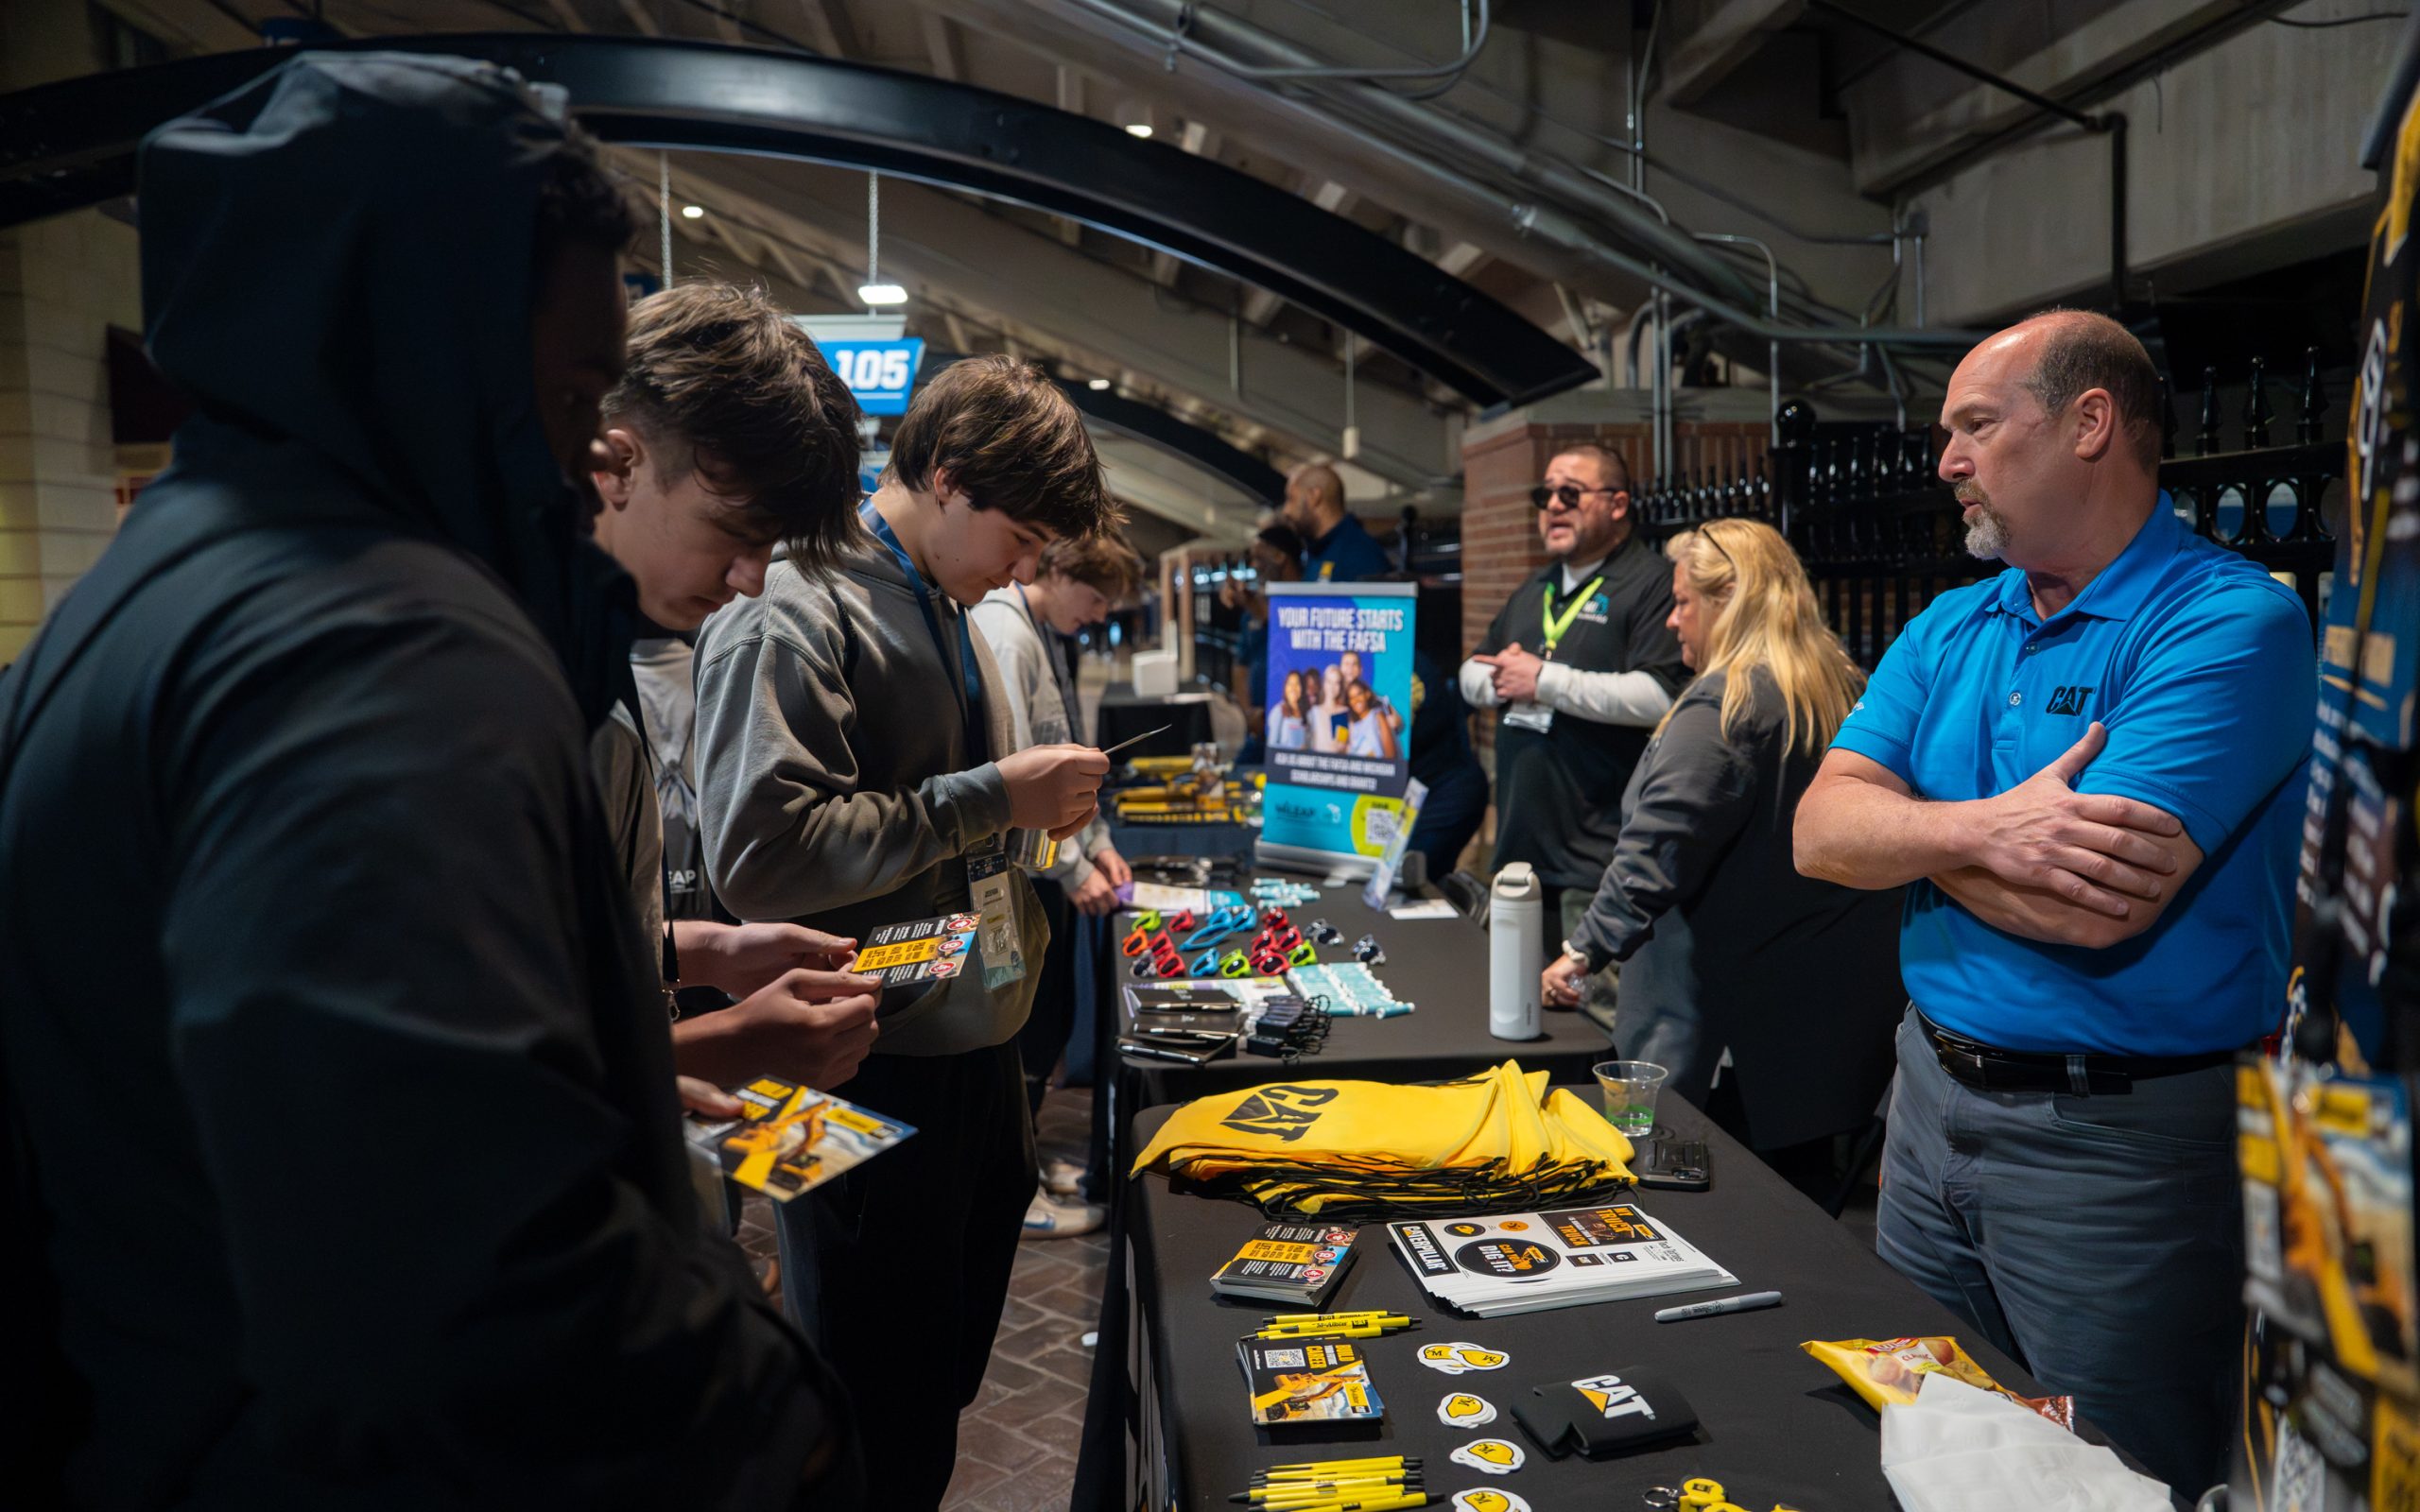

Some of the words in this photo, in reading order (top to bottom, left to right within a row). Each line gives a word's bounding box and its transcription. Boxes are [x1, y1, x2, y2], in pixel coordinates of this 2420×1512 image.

[836, 349, 910, 390] 105
[1278, 607, 1308, 627] YOUR
[1309, 607, 1355, 629] FUTURE
[1357, 609, 1404, 631] STARTS
[1290, 628, 1322, 650] WITH
[1323, 629, 1346, 650] THE
[1347, 630, 1387, 652] FAFSA
[2046, 685, 2095, 716] CAT
[1219, 1085, 1340, 1143] CAT
[1596, 1209, 1631, 1233] TRUCK
[1558, 1225, 1591, 1246] TRUCK
[1403, 1226, 1446, 1270] CATERPILLAR
[1478, 1245, 1505, 1261] DIG
[1490, 1260, 1516, 1272] IT?
[1305, 1345, 1327, 1368] CAREER
[1335, 1344, 1356, 1362] BUILD
[1570, 1374, 1654, 1419] CAT
